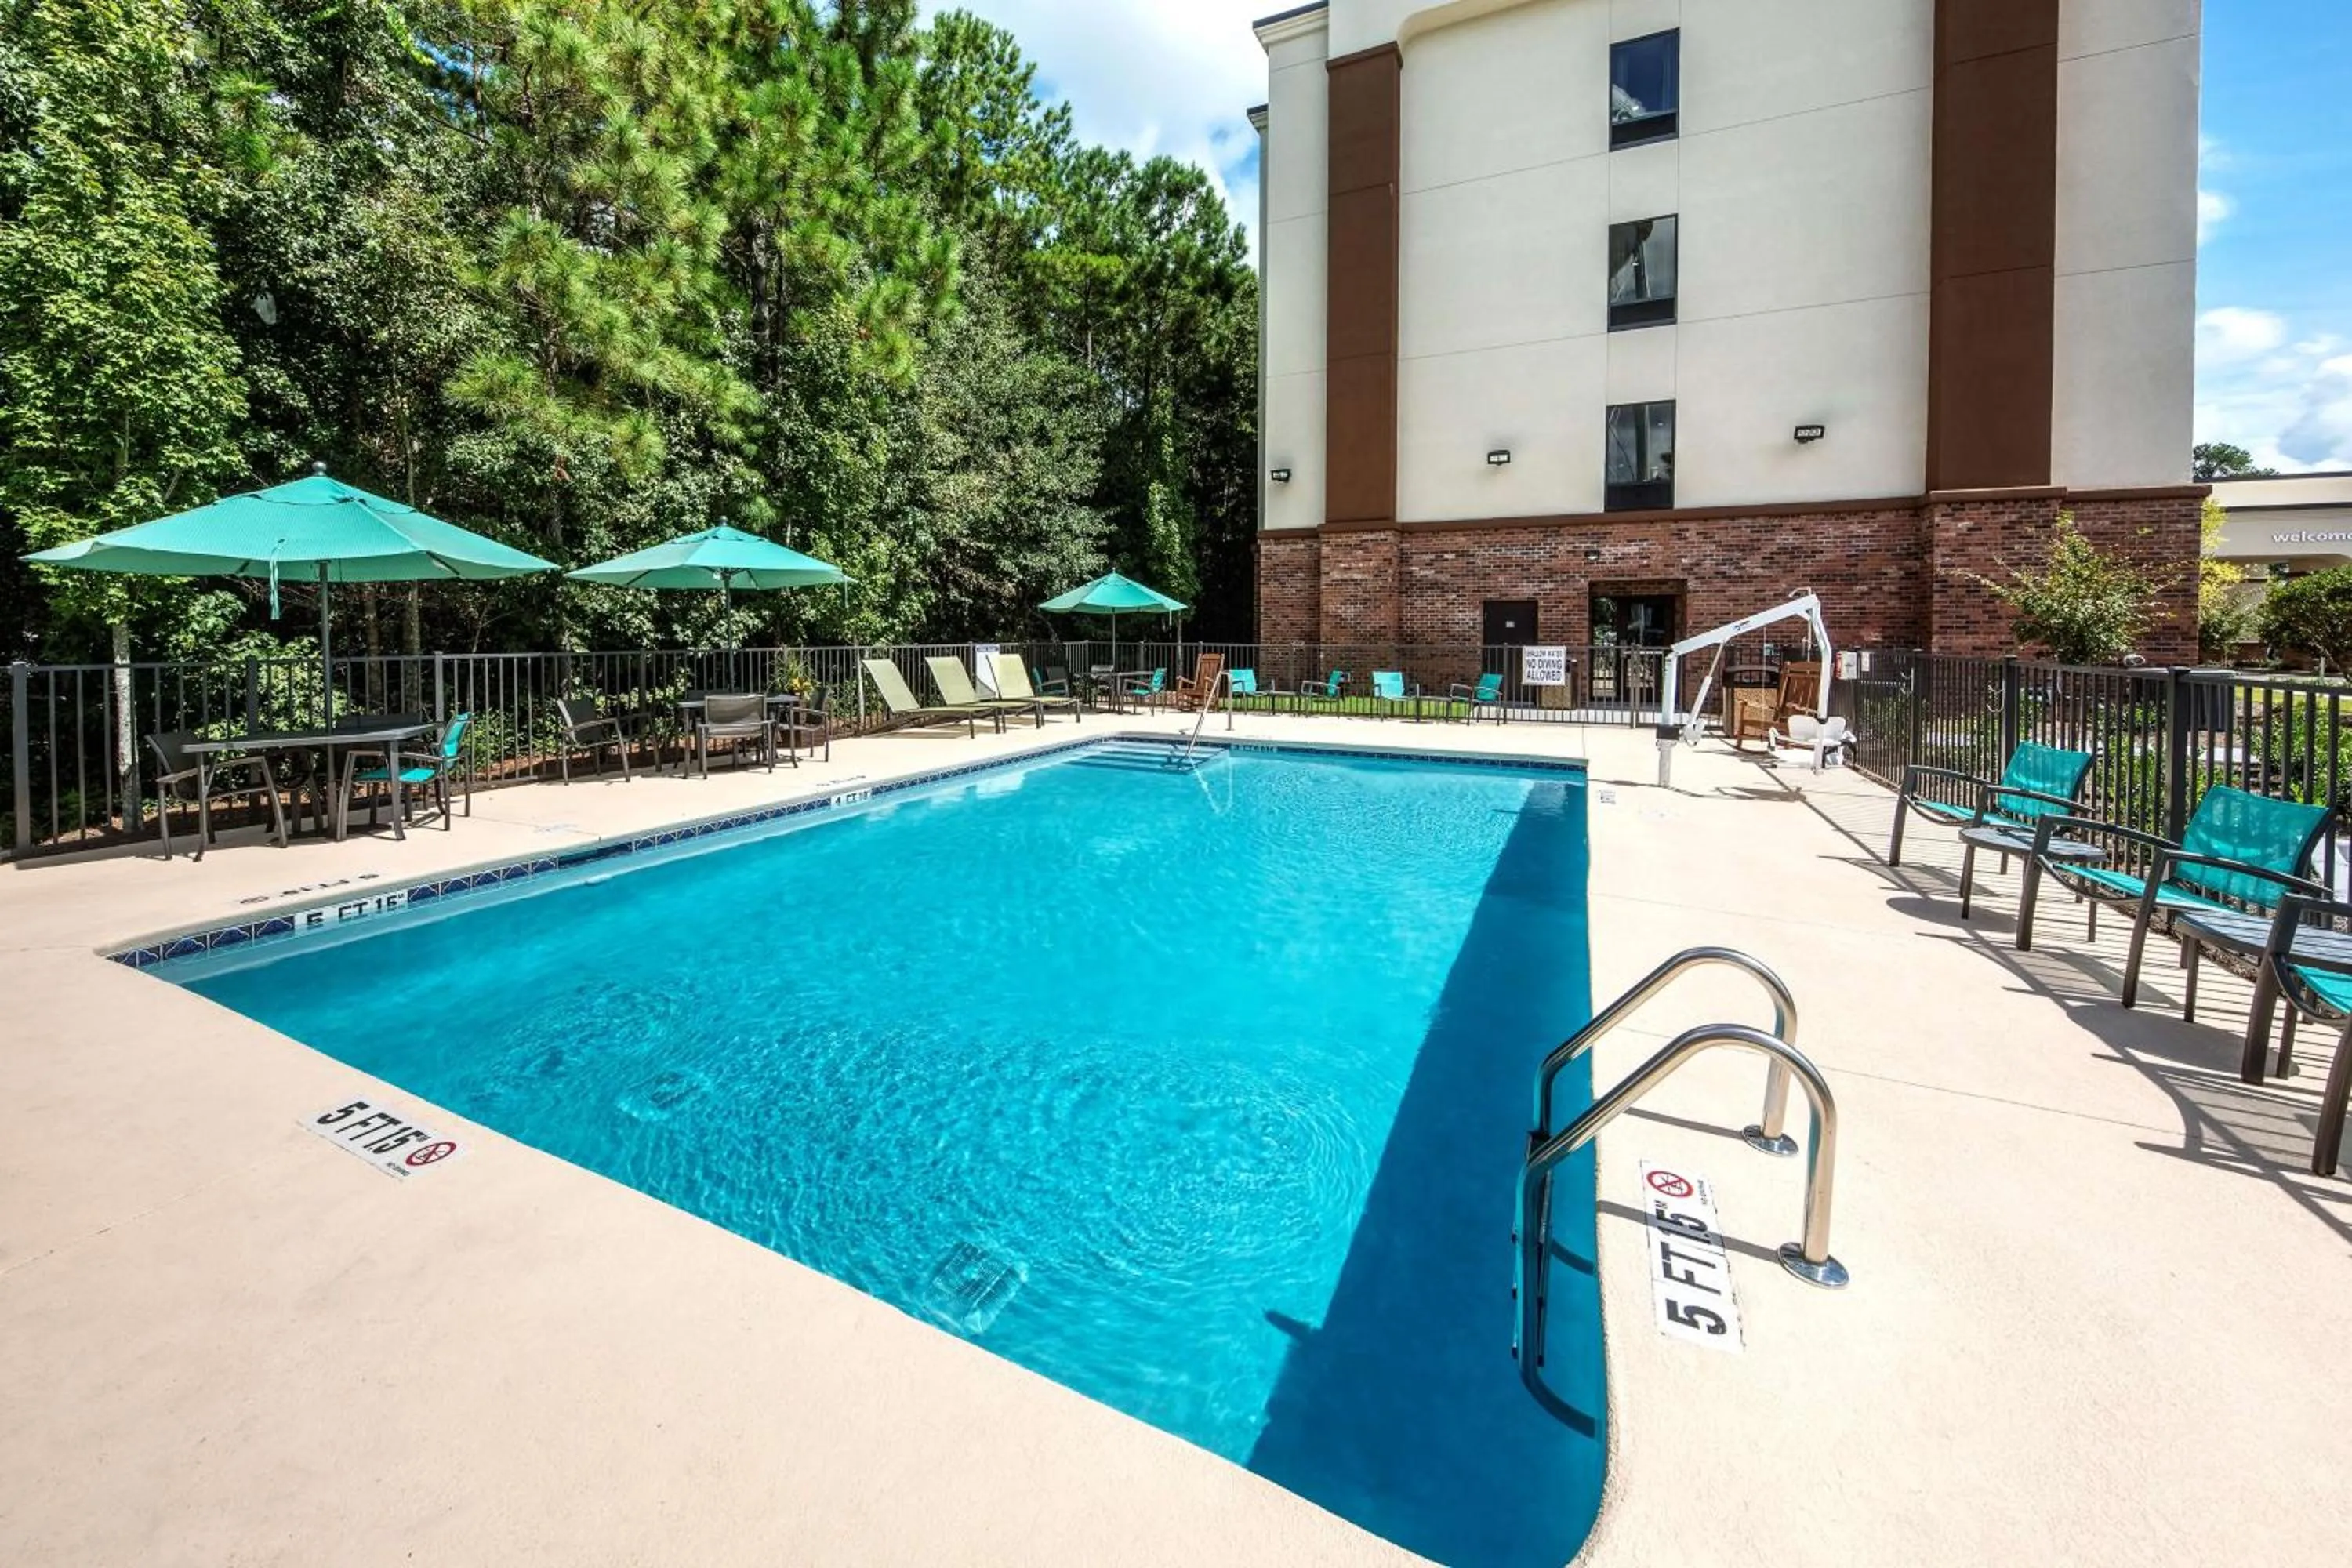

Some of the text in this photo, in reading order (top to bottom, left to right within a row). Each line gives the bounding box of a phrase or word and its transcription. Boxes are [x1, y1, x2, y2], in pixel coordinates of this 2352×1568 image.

[1526, 659, 1563, 670] NO DIVING
[1526, 670, 1562, 681] ALLOWED
[317, 1101, 370, 1124] 5
[335, 1112, 403, 1141] FT
[1660, 1241, 1722, 1295] FT
[1665, 1298, 1727, 1335] 5
